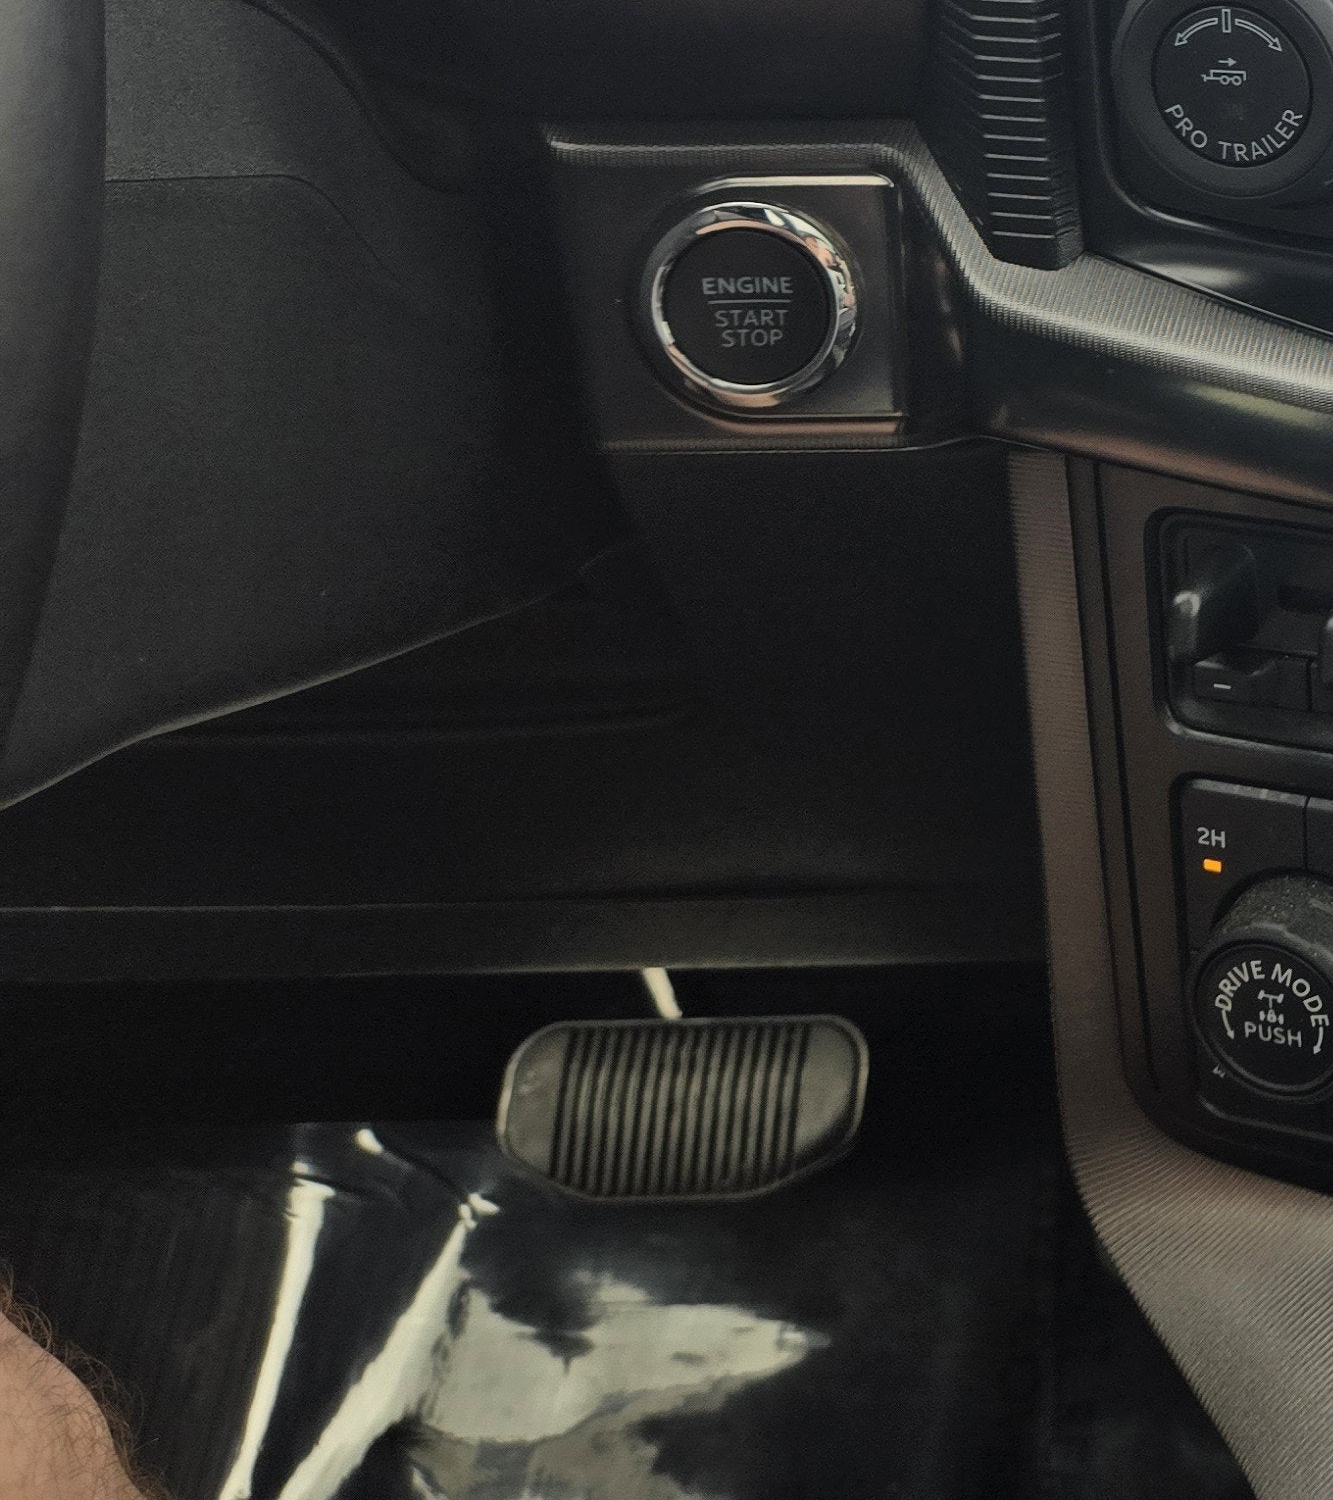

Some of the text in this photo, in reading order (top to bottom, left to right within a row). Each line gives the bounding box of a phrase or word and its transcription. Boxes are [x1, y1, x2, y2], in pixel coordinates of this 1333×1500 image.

[1165, 104, 1303, 162] PRO TRAILER
[701, 276, 794, 295] ENGINE
[714, 309, 789, 328] START
[721, 329, 784, 348] STOP
[1197, 827, 1226, 848] 2H
[1214, 960, 1330, 1027] DRIVE MODE
[1244, 1020, 1302, 1048] PUSH
